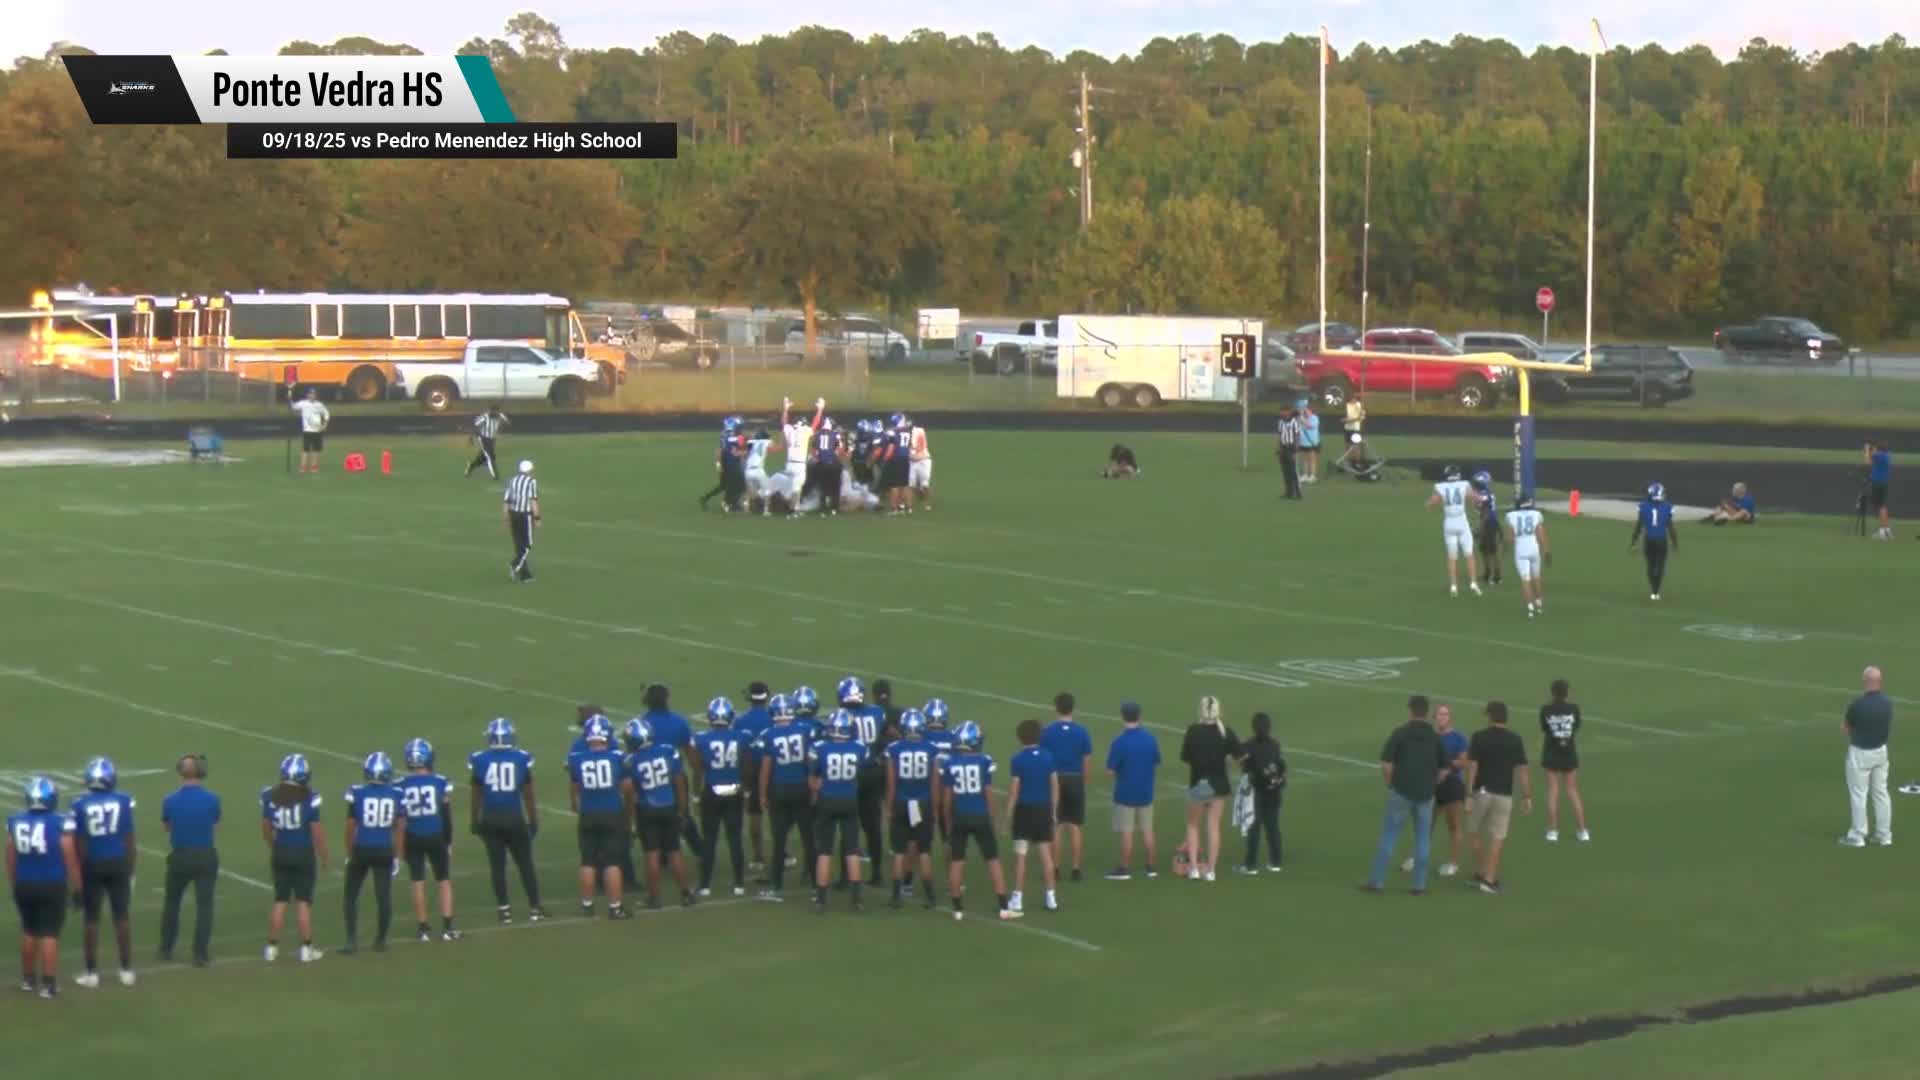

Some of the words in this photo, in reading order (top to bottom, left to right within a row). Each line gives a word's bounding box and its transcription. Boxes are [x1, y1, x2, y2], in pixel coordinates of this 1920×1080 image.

[1222, 337, 1246, 373] 29
[1516, 516, 1534, 537] 18
[709, 740, 739, 769] 34
[774, 733, 805, 764] 33
[485, 761, 516, 792] 40
[581, 760, 613, 790] 60
[638, 758, 669, 789] 32
[827, 752, 858, 781] 86
[950, 764, 982, 795] 38
[363, 798, 395, 828] 80
[405, 785, 438, 816] 23
[86, 802, 120, 836] 27
[15, 822, 47, 855] 64
